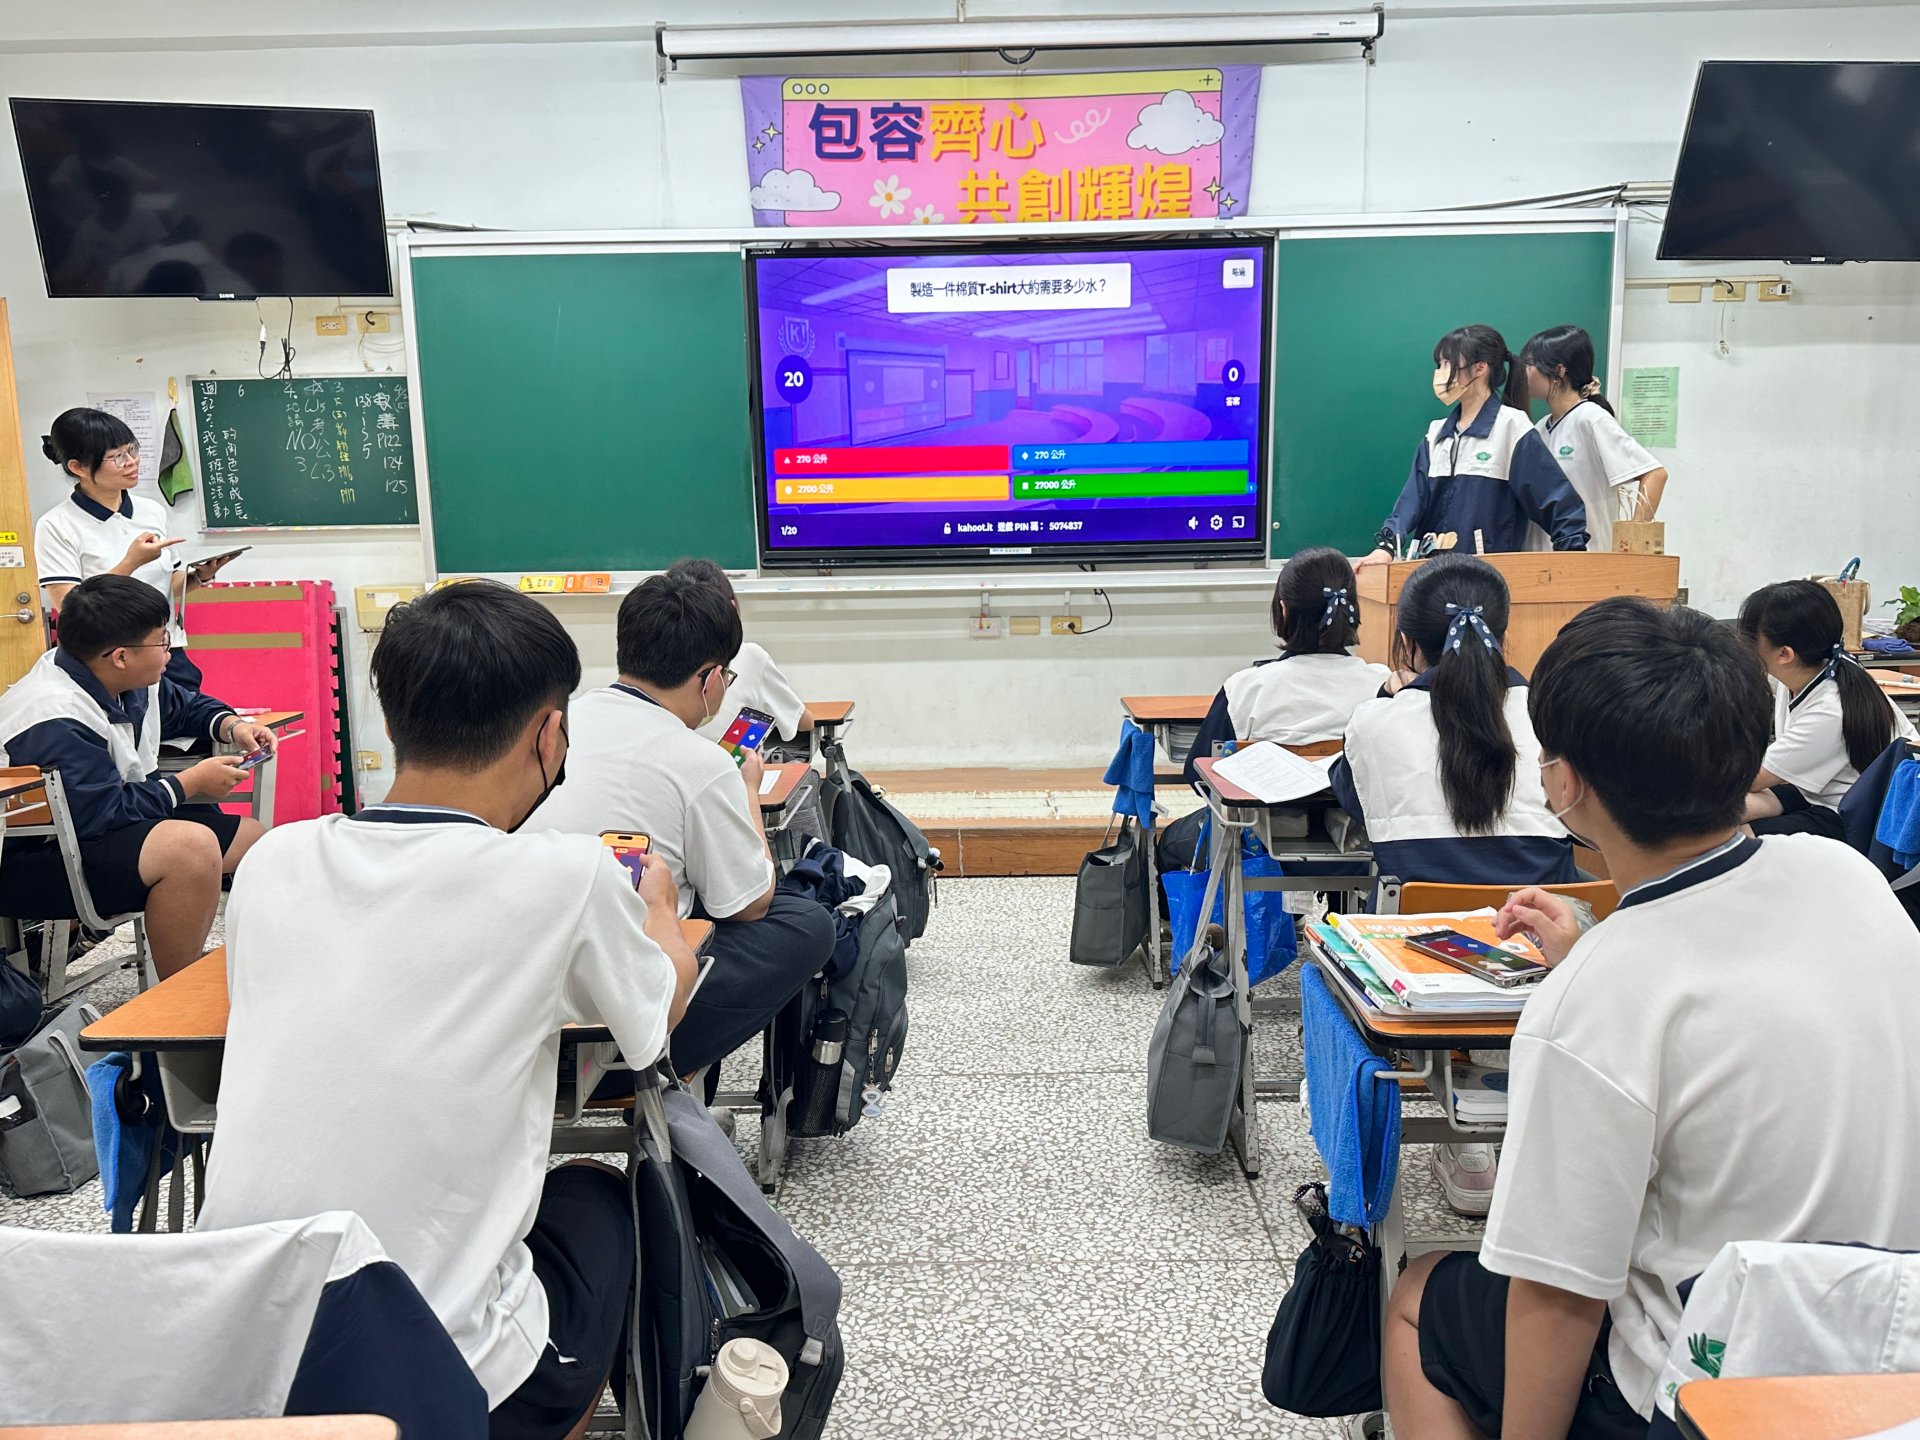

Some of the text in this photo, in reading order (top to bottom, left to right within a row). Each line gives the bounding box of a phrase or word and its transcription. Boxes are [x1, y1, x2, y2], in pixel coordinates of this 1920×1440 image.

[808, 102, 1046, 161] 包容齊心
[956, 162, 1193, 224] 共創輝煌
[784, 371, 804, 387] 20
[1228, 367, 1239, 382] 0
[238, 384, 245, 397] 6
[796, 455, 811, 464] 270
[1034, 451, 1049, 460] 270
[385, 480, 408, 494] 125
[798, 485, 817, 494] 2700
[1034, 480, 1059, 490] 27000
[781, 525, 797, 536] 1/20
[957, 522, 994, 532] kahoot.it
[1015, 522, 1029, 531] PIN
[1049, 521, 1083, 531] 5074837
